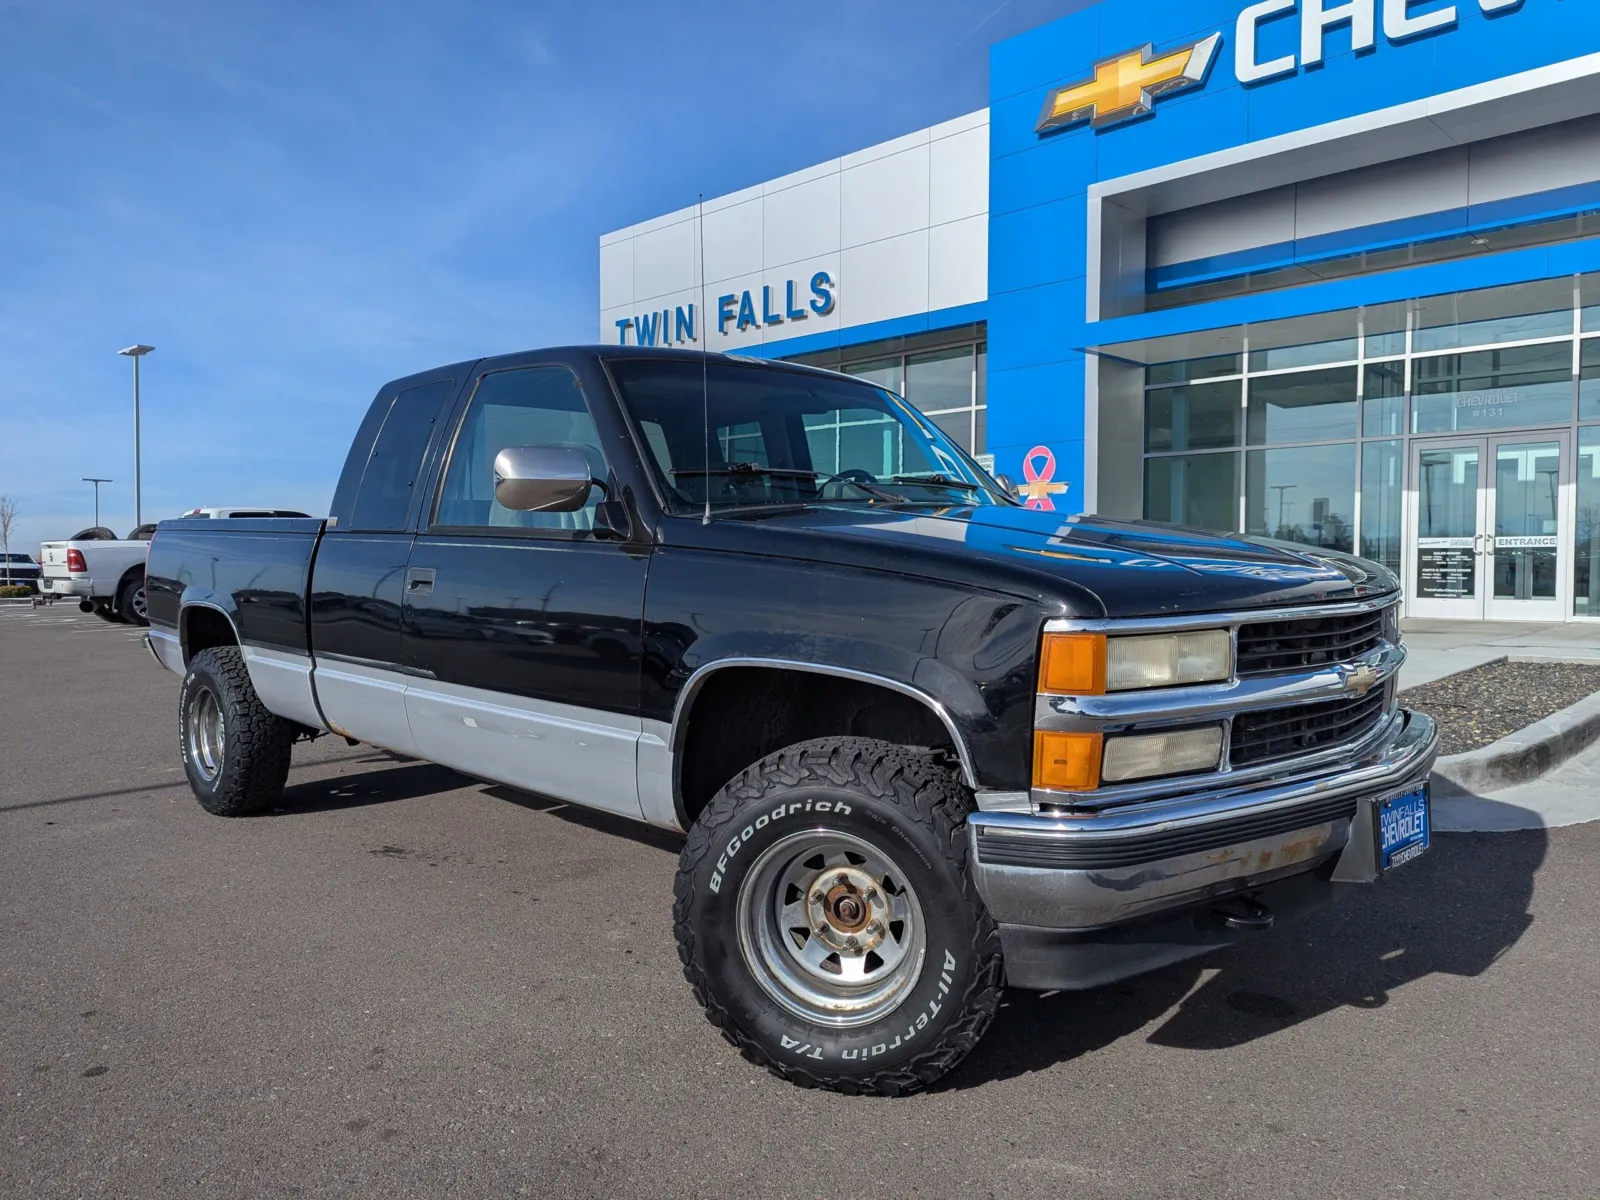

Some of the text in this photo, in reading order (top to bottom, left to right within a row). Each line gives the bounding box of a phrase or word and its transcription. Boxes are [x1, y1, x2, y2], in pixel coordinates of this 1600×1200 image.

[1234, 0, 1525, 83] CH
[615, 271, 836, 346] TWIN FALLS
[1456, 391, 1520, 408] CHEVROLET
[1472, 406, 1503, 418] #131
[1498, 537, 1556, 546] ENTRANCE
[708, 798, 853, 895] BFGoodrich
[779, 948, 957, 1062] All-Terrain T/A
